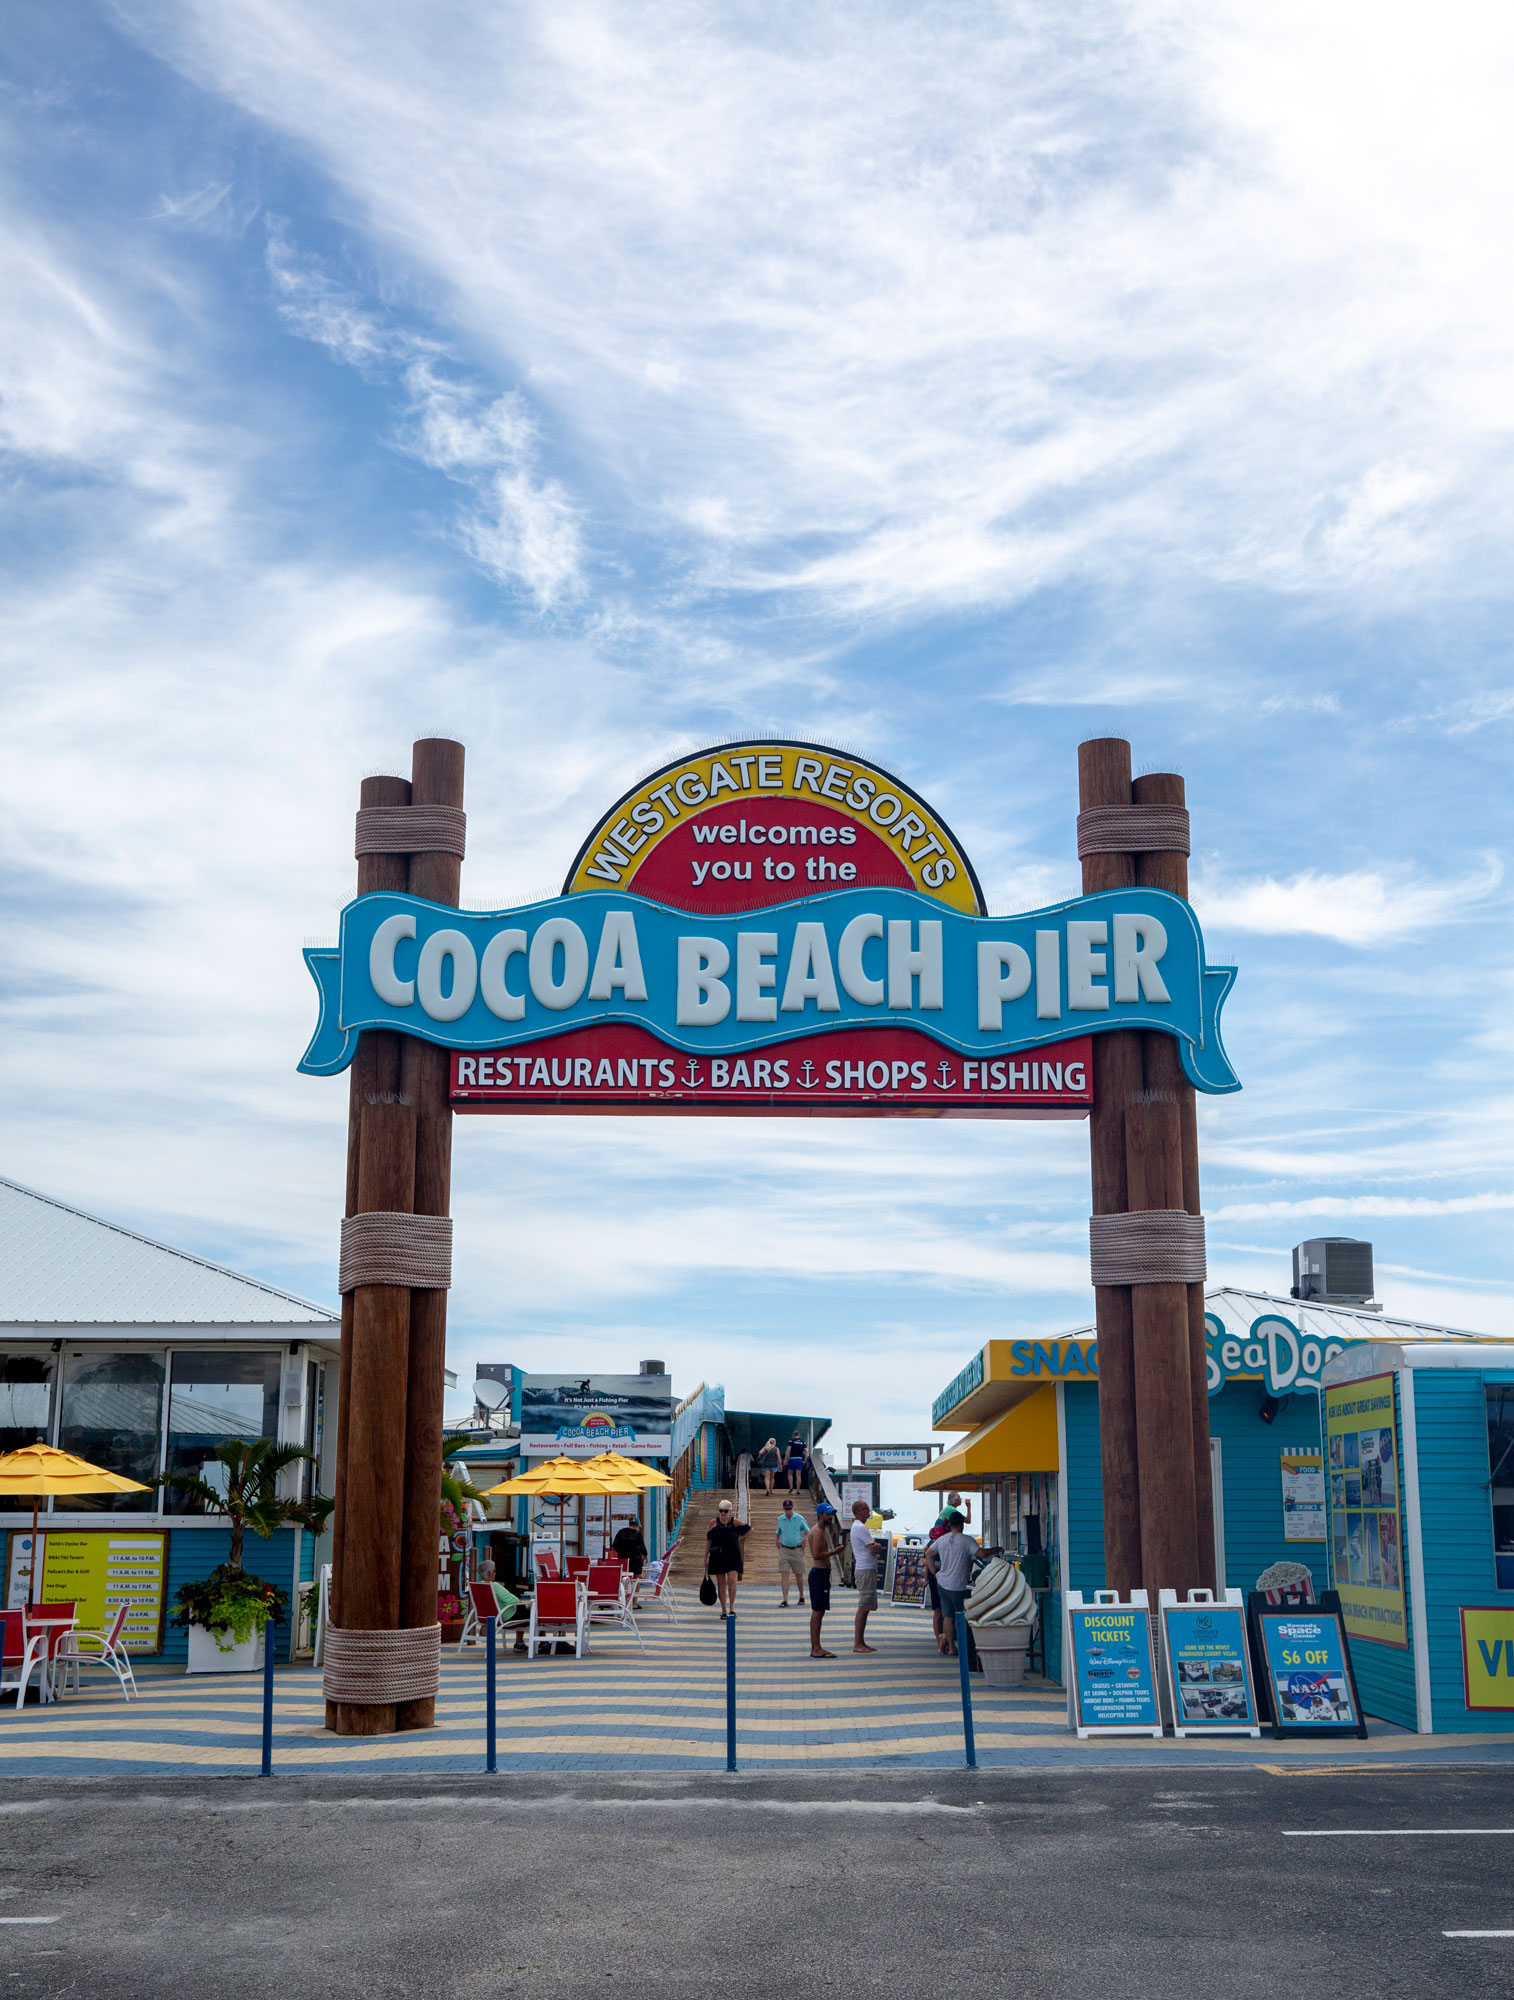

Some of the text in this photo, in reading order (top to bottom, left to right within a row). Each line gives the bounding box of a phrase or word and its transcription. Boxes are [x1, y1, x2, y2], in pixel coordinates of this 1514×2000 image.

[586, 754, 956, 889] WESTGATE RESORTS
[691, 819, 857, 845] welcomes
[691, 855, 857, 886] you to the
[369, 910, 1172, 1031] COCOA BEACH PIER
[457, 1056, 1087, 1091] RESTAURANTS BARS SHOPS FISHING
[1342, 1402, 1356, 1416] ABOUT
[1357, 1399, 1370, 1413] GREAT
[562, 1428, 629, 1437] COCOA BEACH PIER
[438, 1536, 450, 1591] ATM
[1084, 1616, 1135, 1627] DISCOUNT
[1091, 1630, 1130, 1642] TICKETS
[1278, 1626, 1321, 1635] Space
[1282, 1650, 1328, 1666] $6 OFF
[1290, 1684, 1328, 1694] NASA
